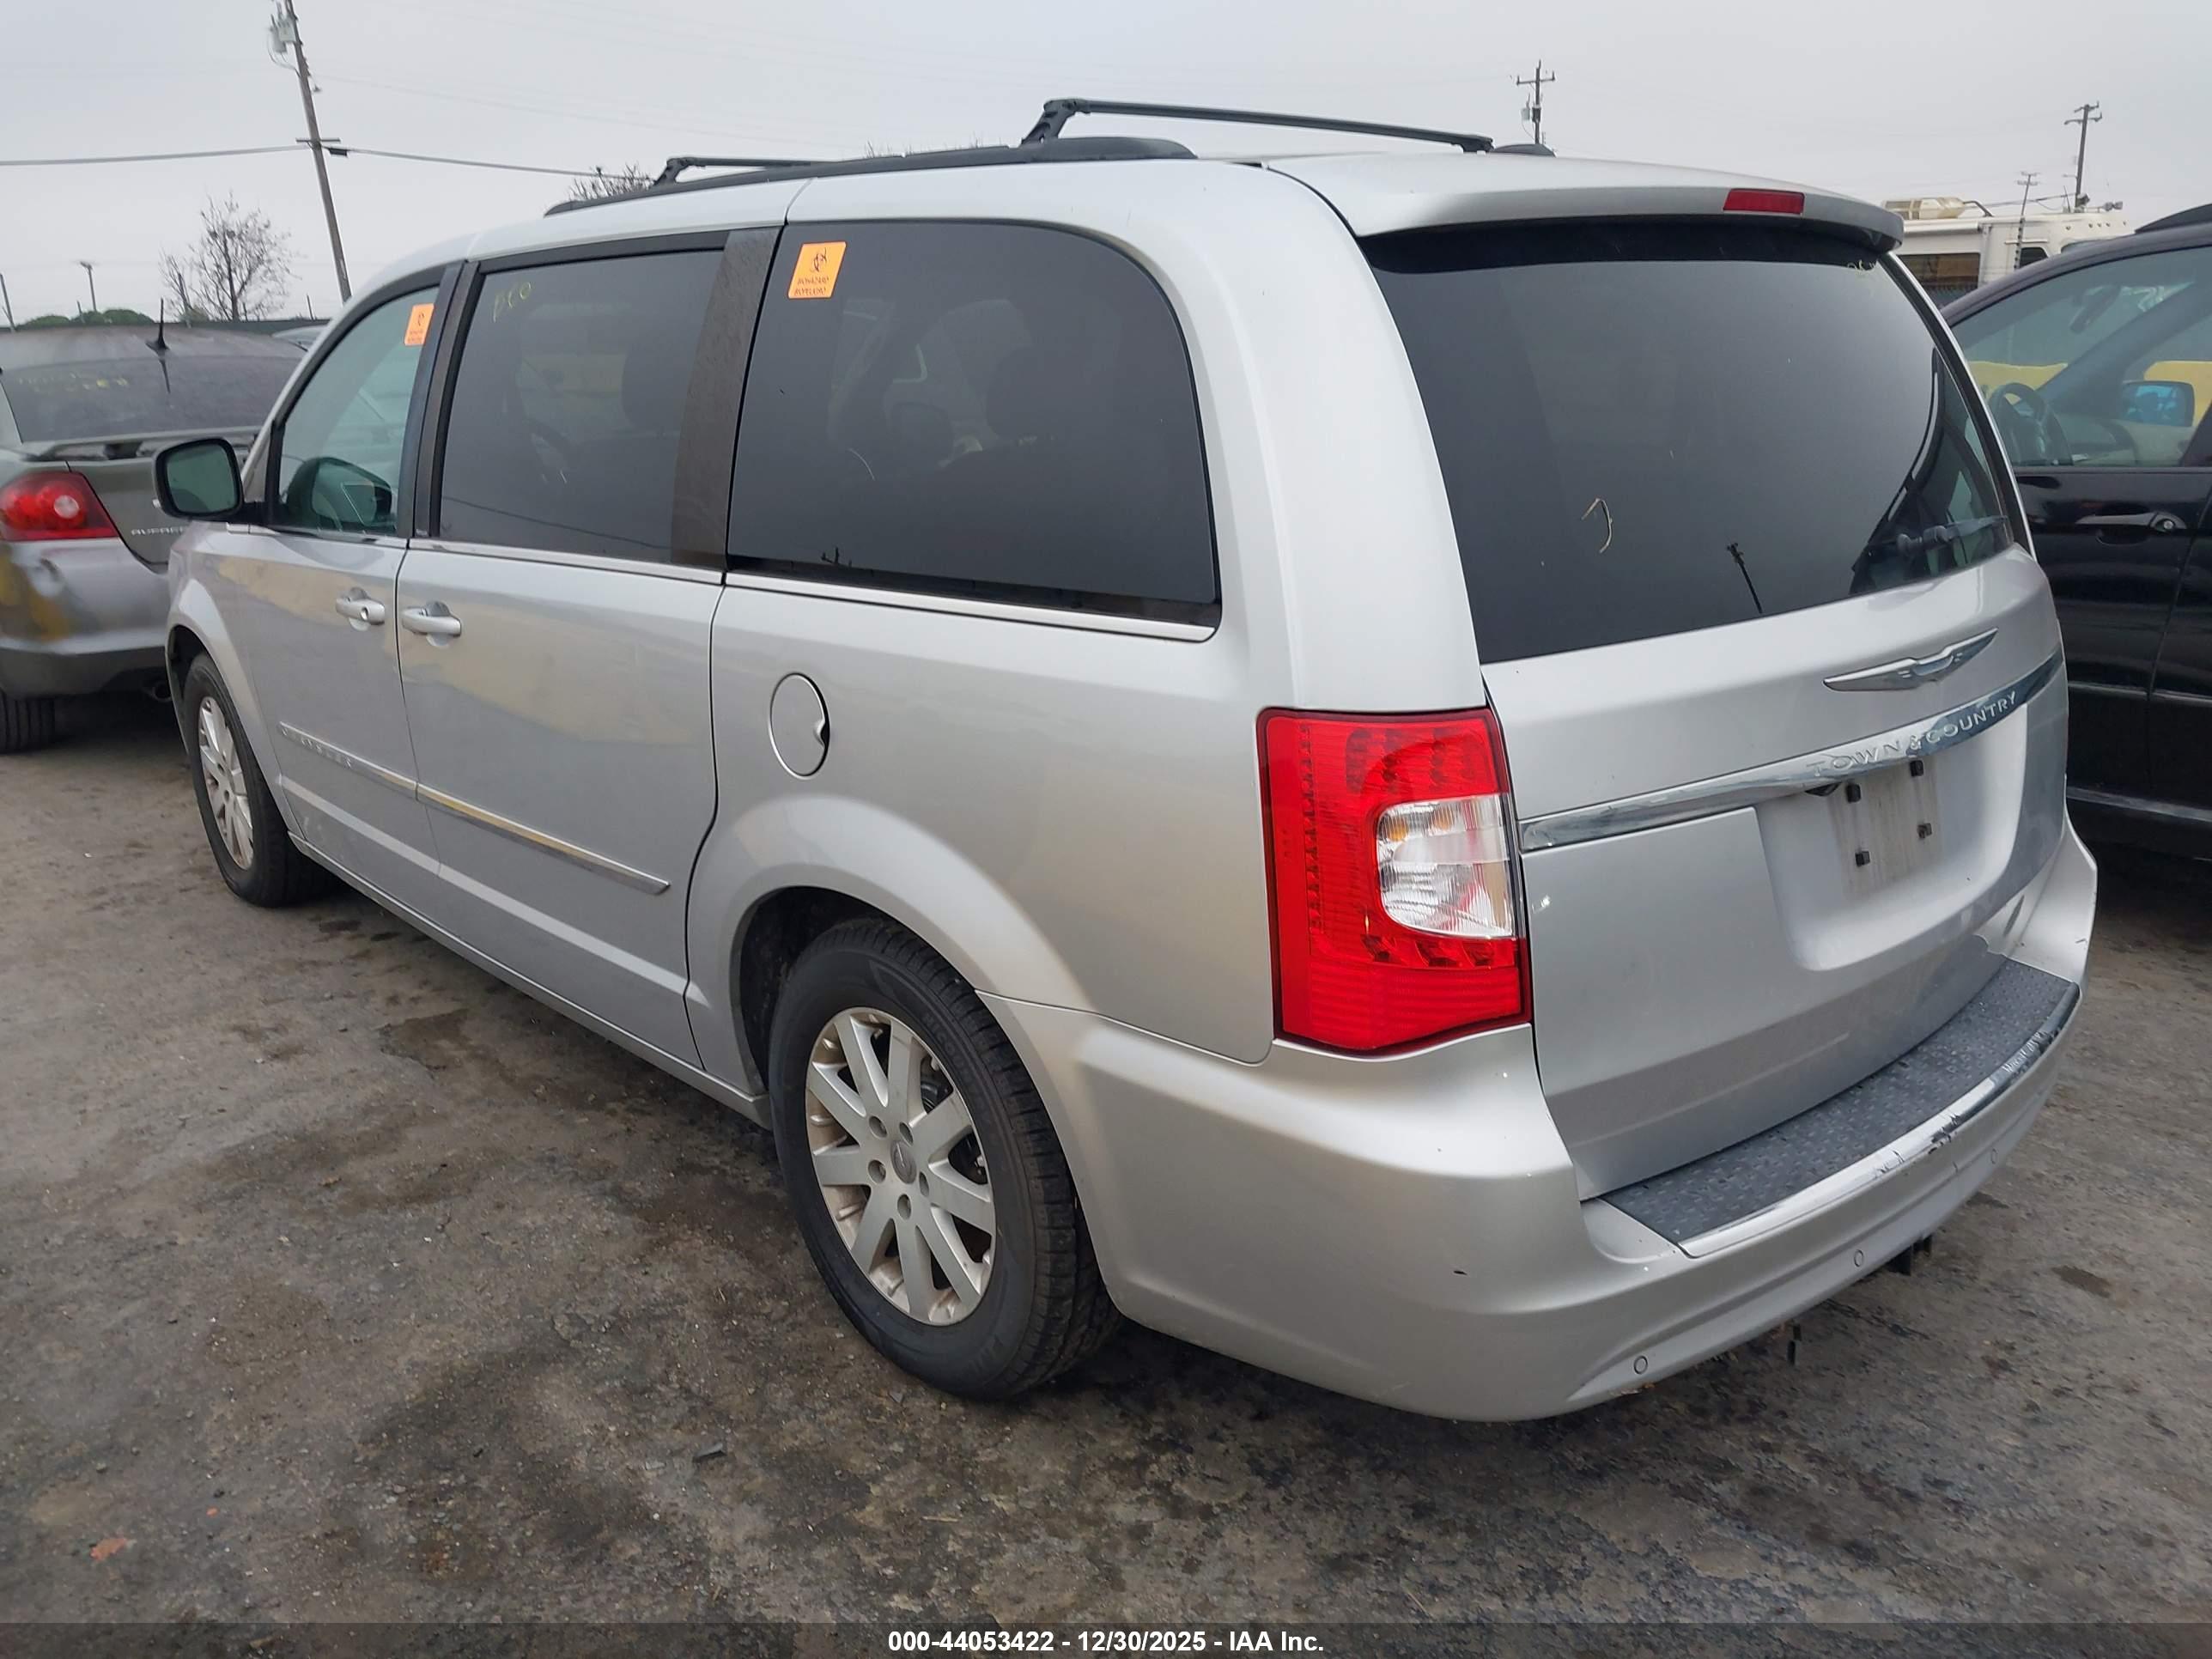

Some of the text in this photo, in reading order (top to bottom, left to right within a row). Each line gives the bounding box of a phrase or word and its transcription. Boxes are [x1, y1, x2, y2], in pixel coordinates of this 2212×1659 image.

[1807, 690, 2018, 777] TOWN & COUNTRY
